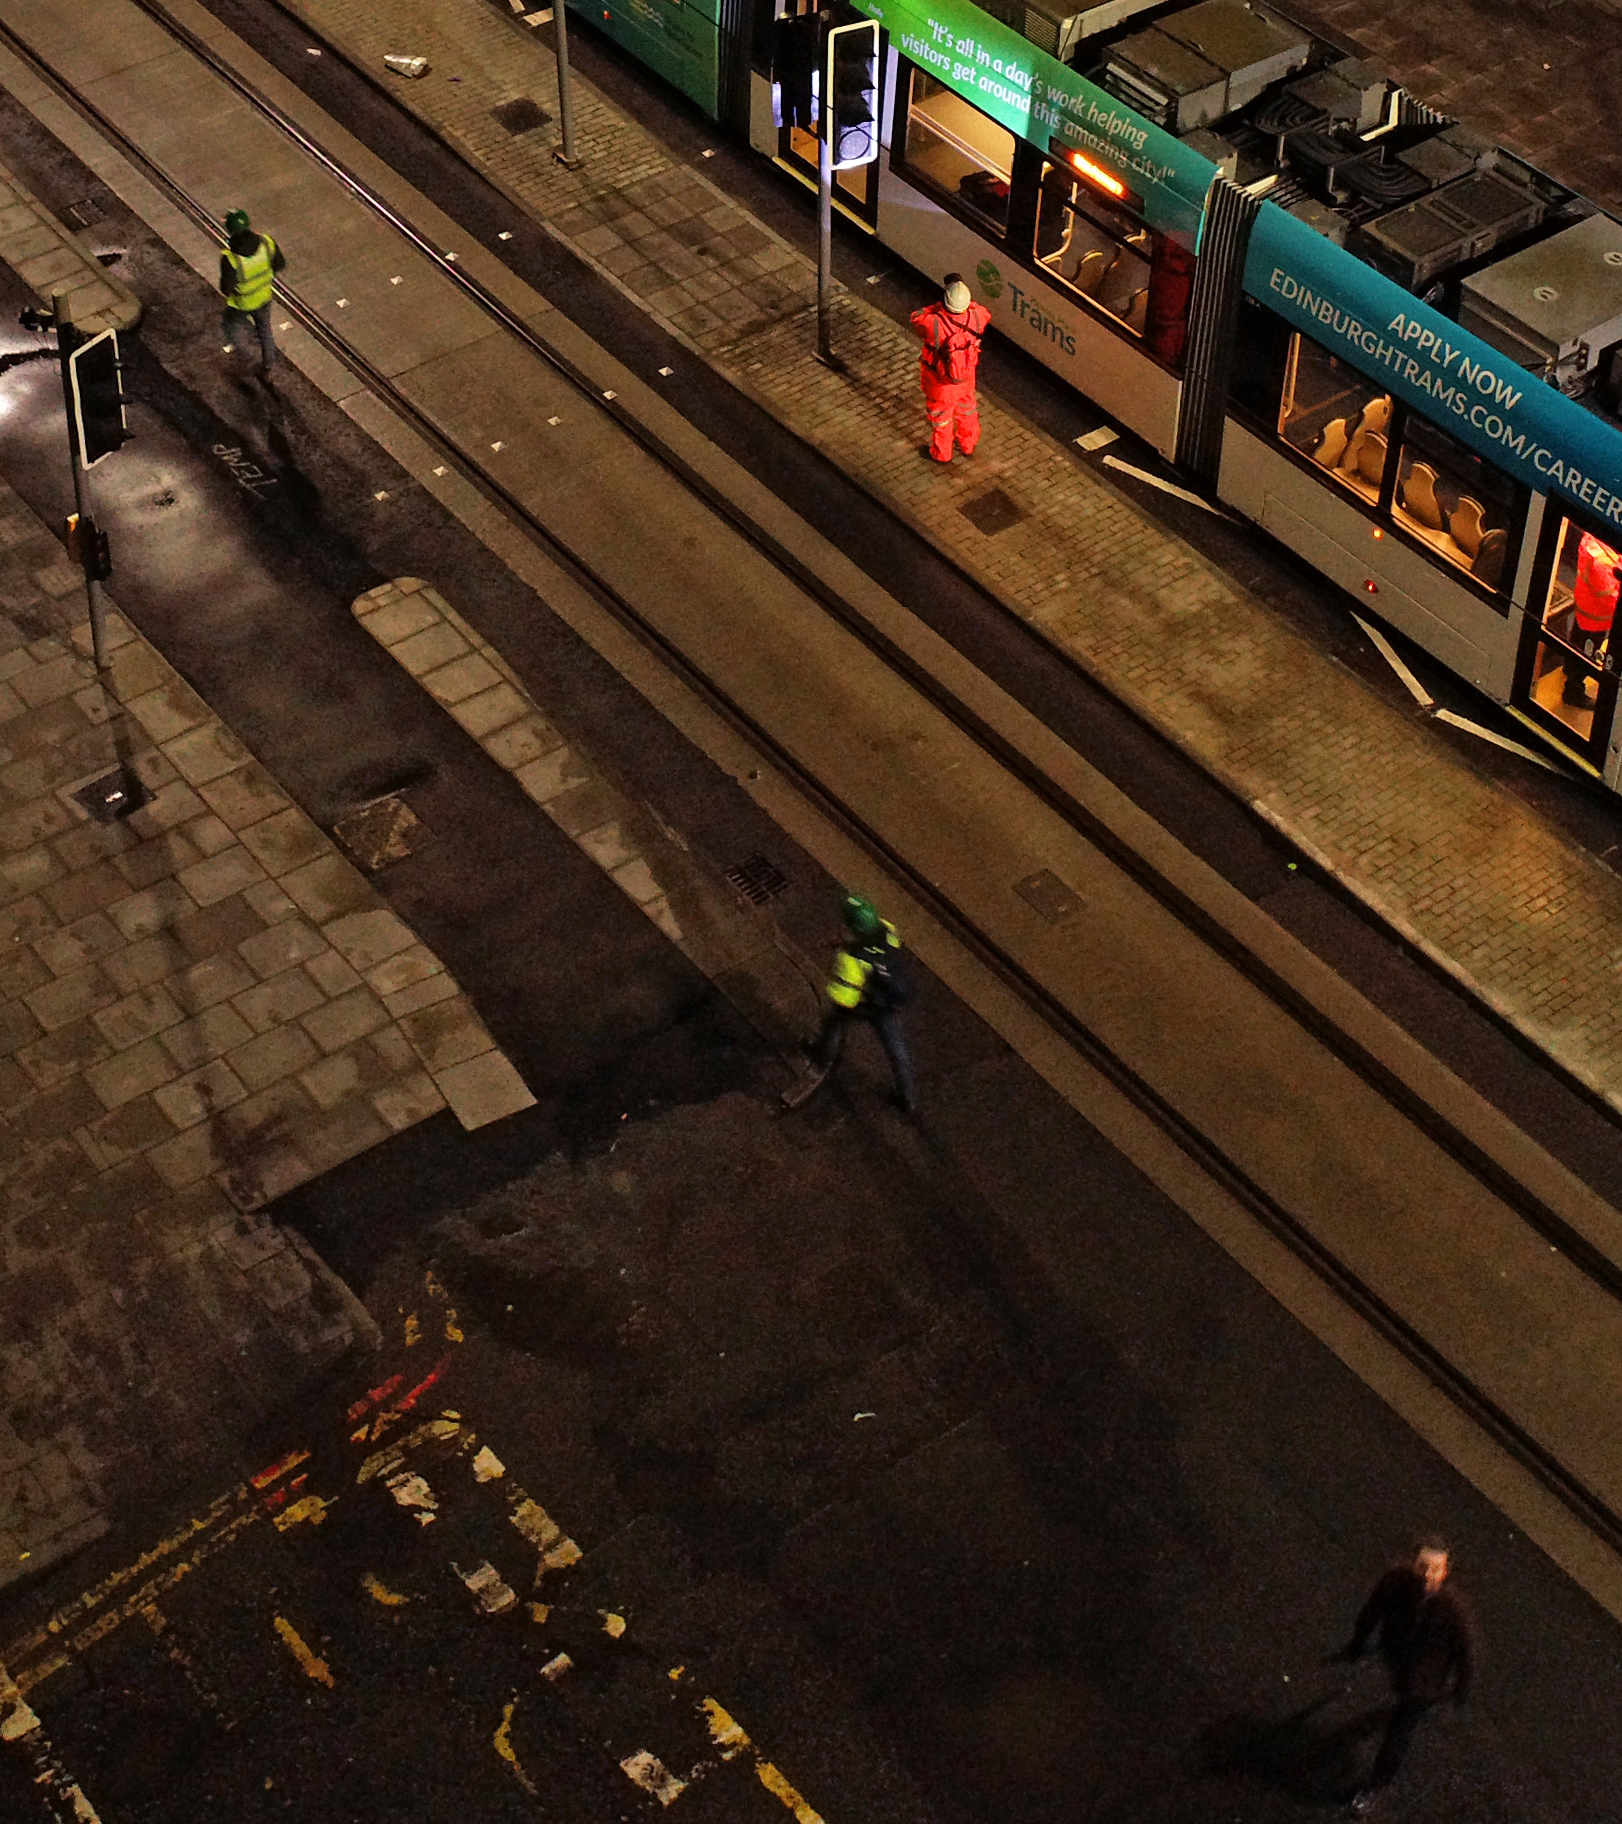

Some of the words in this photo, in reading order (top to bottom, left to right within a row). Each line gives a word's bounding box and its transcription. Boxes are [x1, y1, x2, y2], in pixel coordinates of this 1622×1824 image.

[901, 33, 951, 72] visitors
[952, 62, 977, 87] get
[978, 77, 1030, 114] around
[1033, 99, 1061, 130] this
[1063, 120, 1128, 169] amazing
[955, 35, 975, 59] all
[976, 43, 991, 68] in
[992, 57, 1003, 74] a
[1005, 61, 1043, 96] day's
[1046, 84, 1086, 119] work
[1087, 101, 1149, 151] helping
[1007, 281, 1077, 356] Trams
[1386, 312, 1462, 368] APPLY
[1457, 355, 1523, 412] NOW
